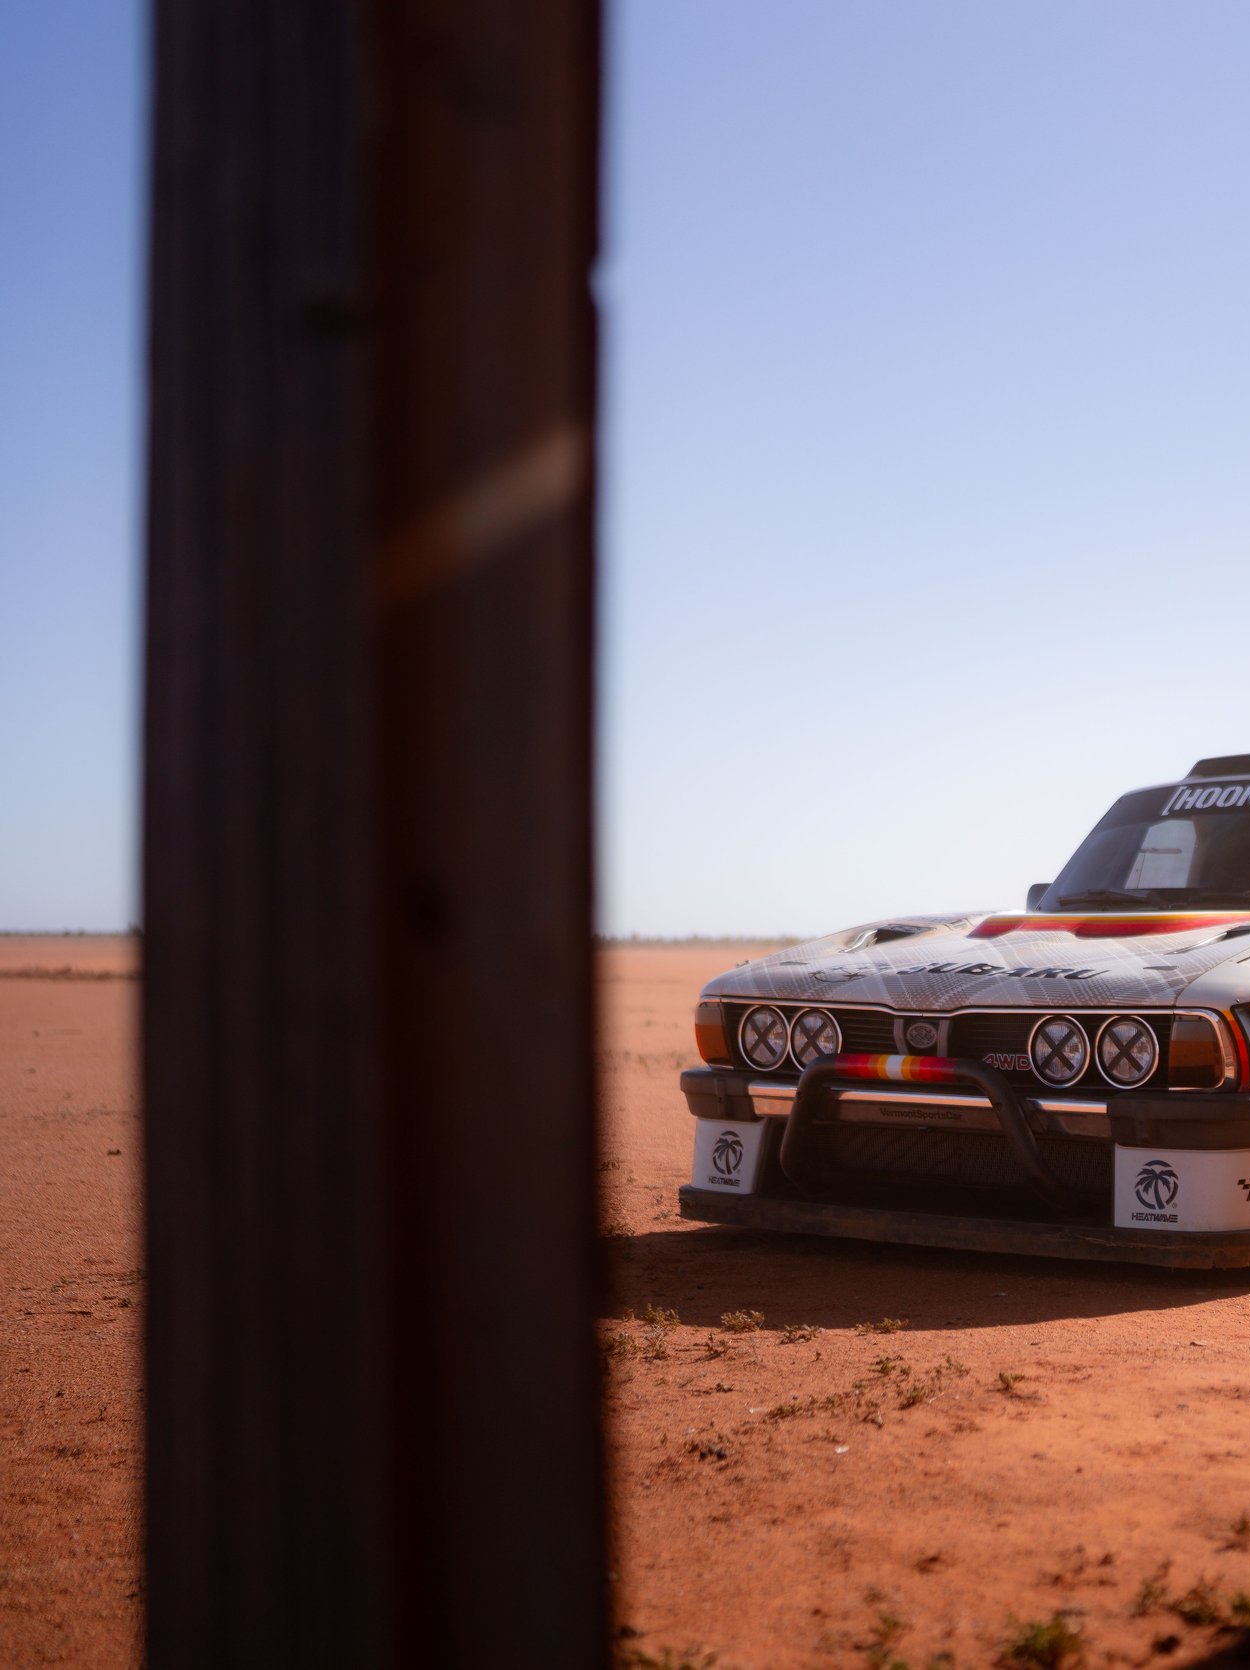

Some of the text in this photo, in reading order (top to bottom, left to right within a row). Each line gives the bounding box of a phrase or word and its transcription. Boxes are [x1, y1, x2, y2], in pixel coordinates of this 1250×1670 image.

[896, 961, 1110, 980] SUBARU
[982, 1053, 1033, 1071] 4WD
[1131, 1212, 1179, 1223] HEATWAVE
